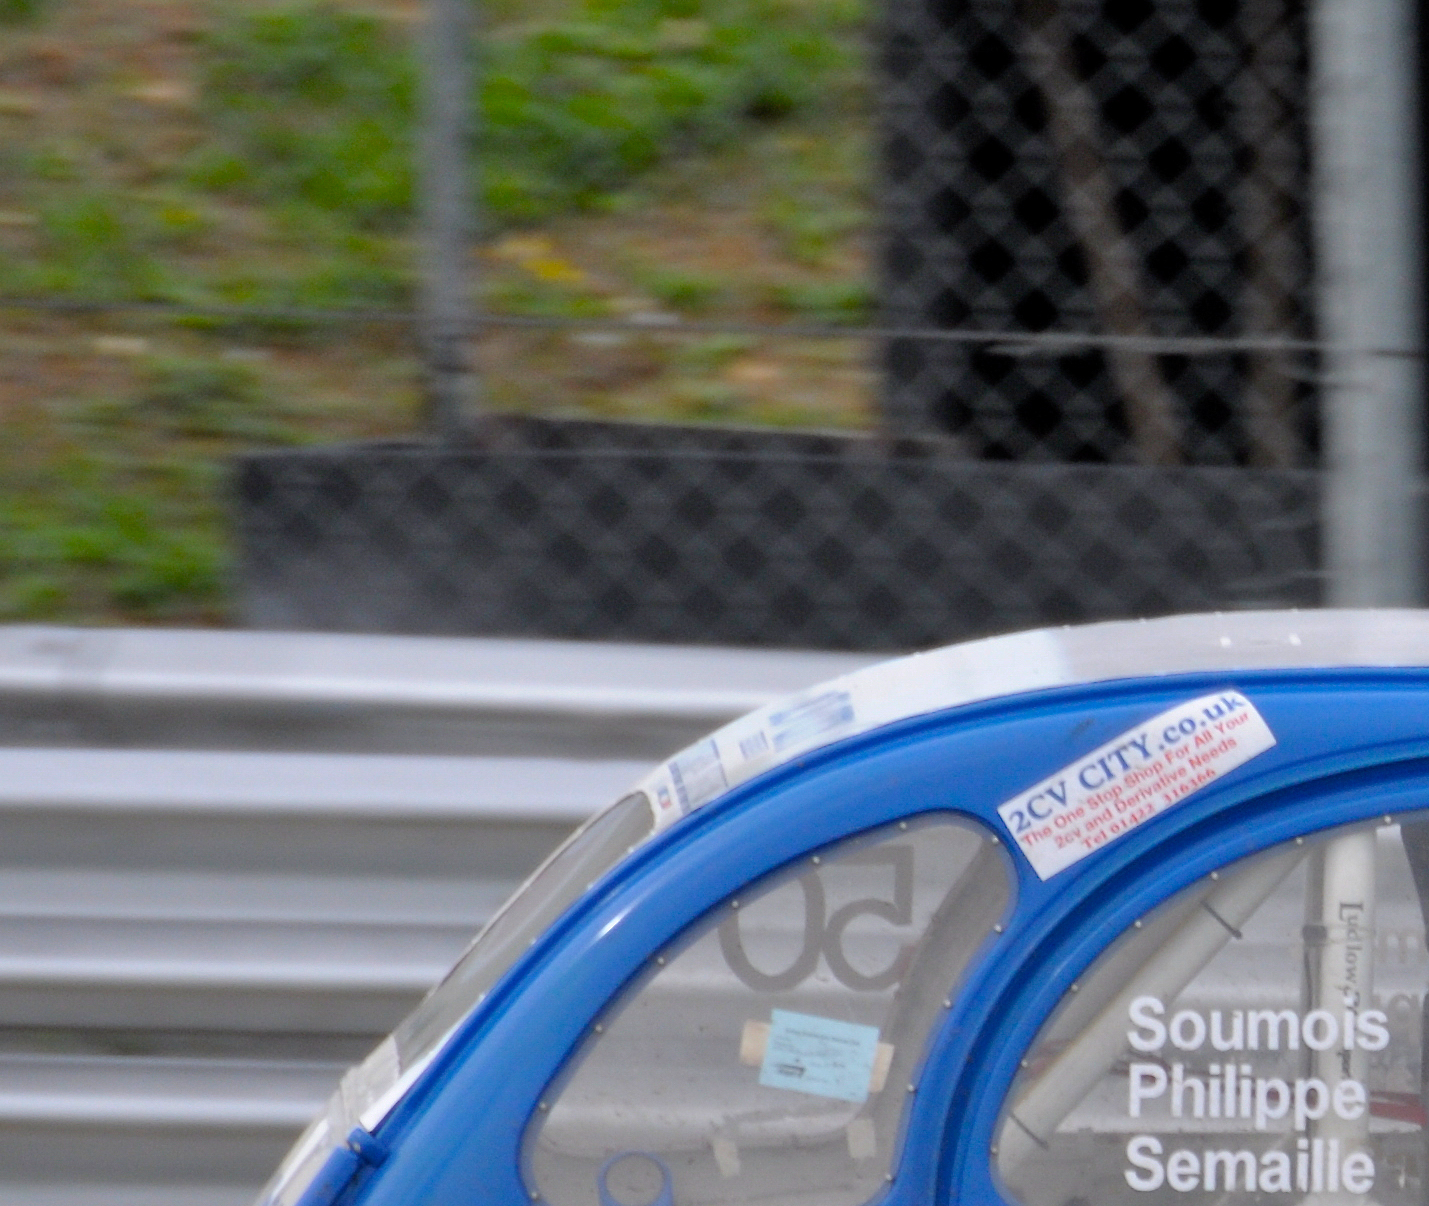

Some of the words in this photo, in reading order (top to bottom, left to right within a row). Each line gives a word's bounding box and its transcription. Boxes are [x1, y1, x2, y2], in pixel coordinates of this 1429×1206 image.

[1009, 782, 1068, 832] 2CV
[1021, 826, 1051, 848] The
[1054, 808, 1085, 828] One
[1086, 785, 1123, 811] Stop
[1124, 760, 1164, 787] Shop
[1165, 744, 1190, 764] For
[1194, 731, 1213, 750] All
[1215, 711, 1250, 735] Your
[1055, 829, 1083, 850] 2cv
[1085, 810, 1113, 832] and
[1116, 767, 1187, 813] Derivative
[1189, 737, 1237, 769] Needs
[1082, 828, 1109, 850] Tel
[1110, 802, 1157, 834] 01422
[1127, 995, 1390, 1052] Soumois
[1128, 1063, 1367, 1130] Philippe
[1124, 1136, 1376, 1193] Semaille
